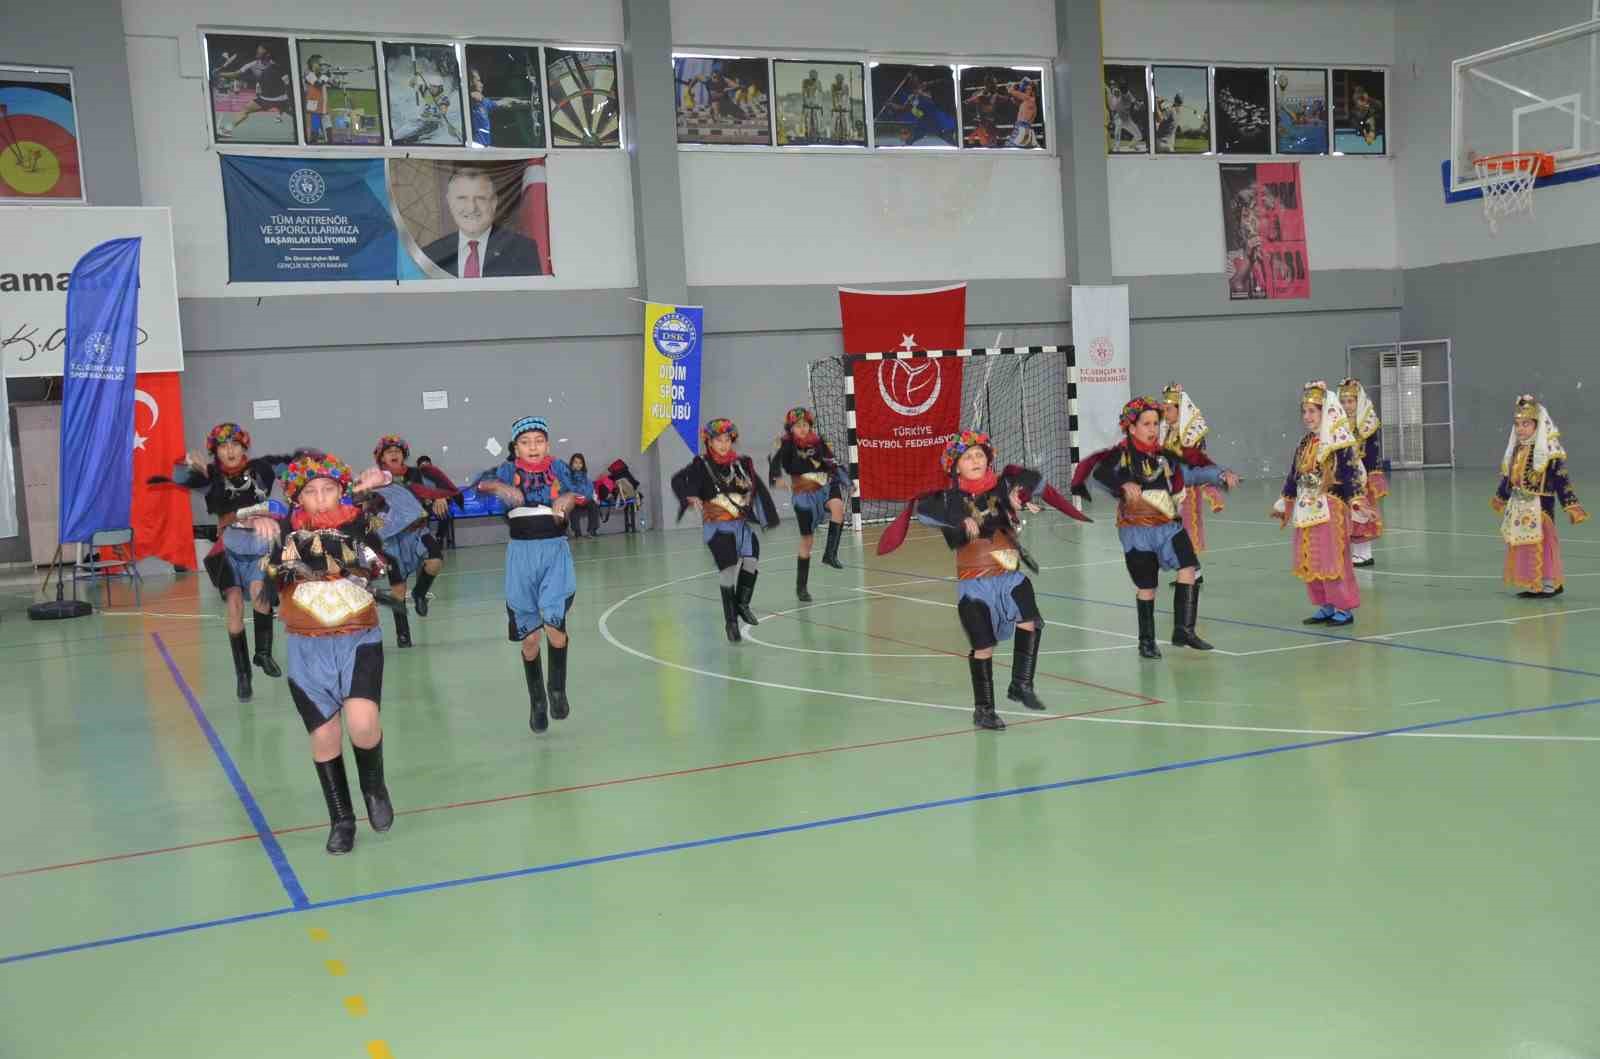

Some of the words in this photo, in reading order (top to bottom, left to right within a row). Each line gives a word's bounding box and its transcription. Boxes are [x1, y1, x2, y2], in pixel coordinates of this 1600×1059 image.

[270, 214, 293, 225] TÜM
[295, 214, 348, 225] ANTRENÖR
[260, 225, 273, 234] VE
[274, 225, 359, 234] SPORCULARIMIZA
[264, 236, 310, 245] BAŞARILAR
[662, 331, 686, 342] DSK
[659, 362, 687, 381] DİDİM
[660, 385, 685, 400] SPOR
[651, 402, 691, 420] KULÜBÜ
[893, 425, 932, 437] TÜRKİYE
[857, 438, 902, 449] VOLEYBOL
[905, 434, 956, 448] FEDERASYO
